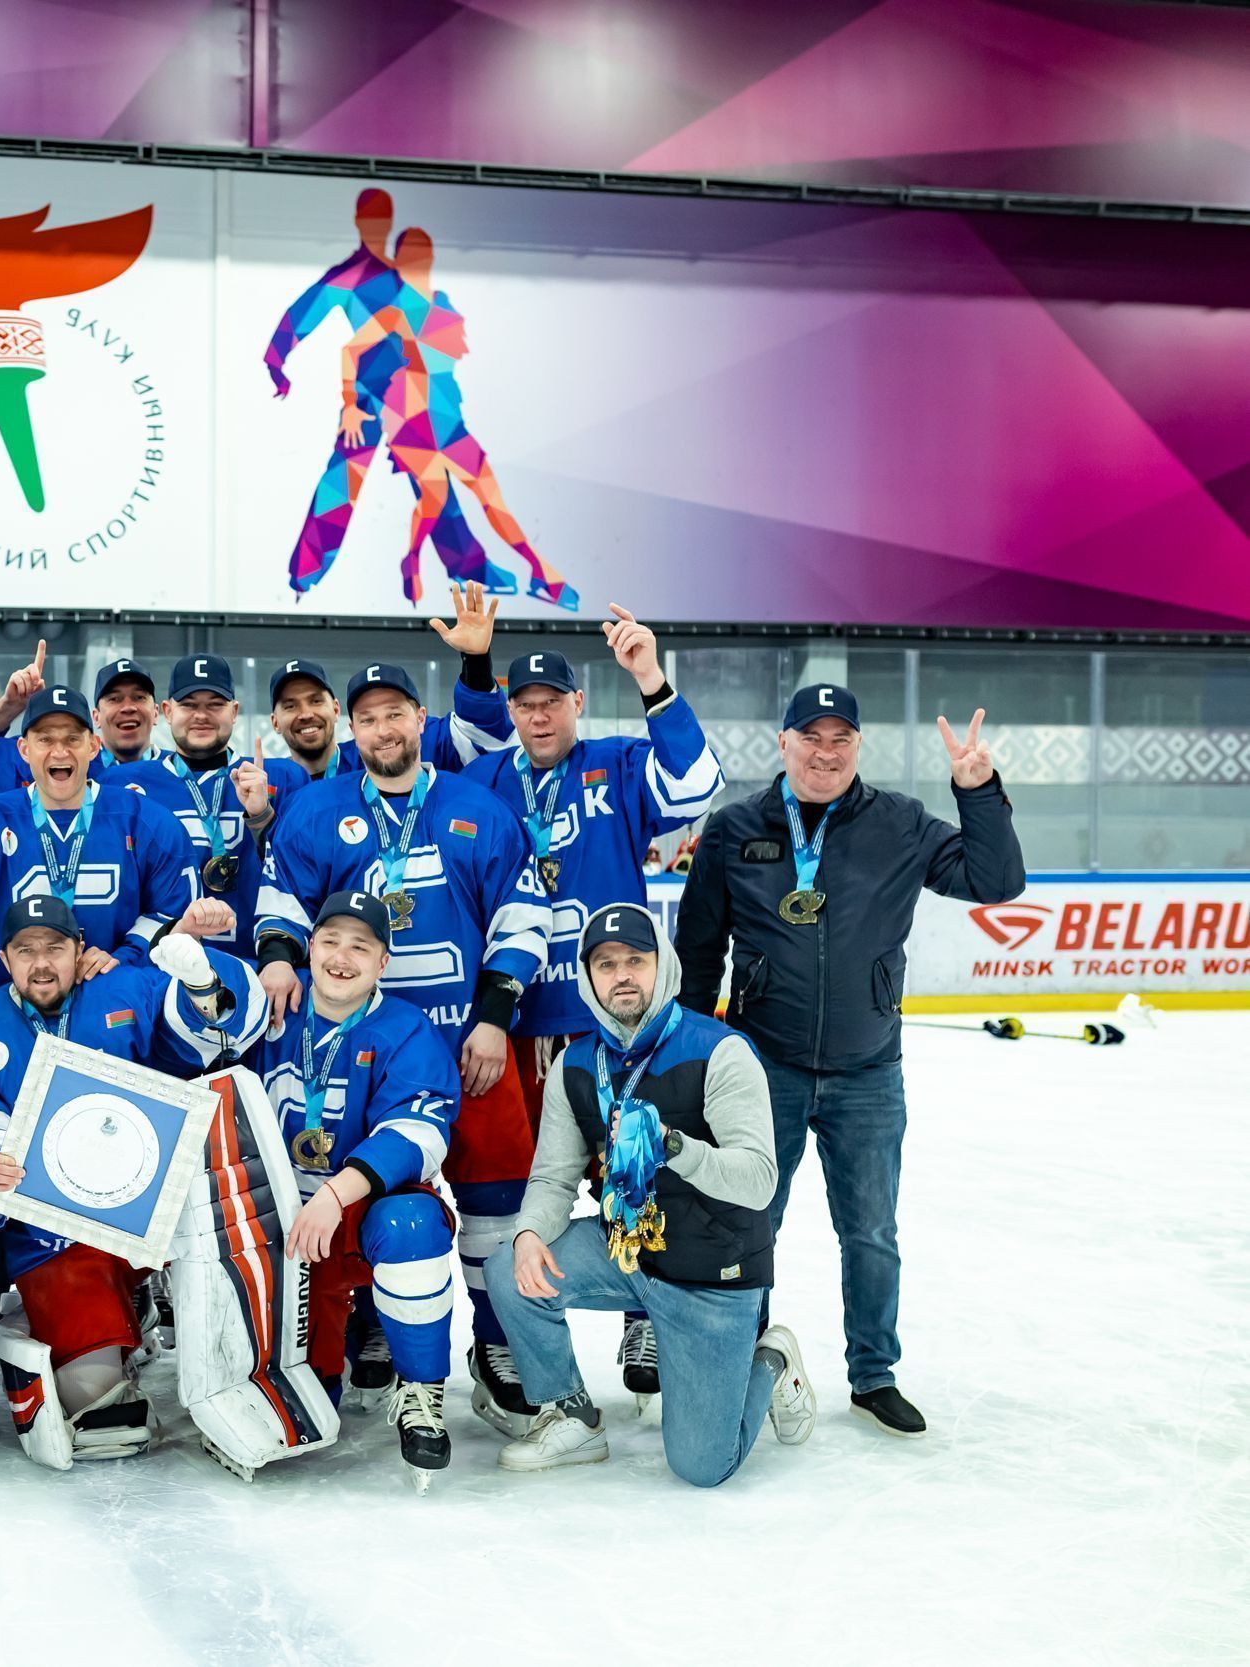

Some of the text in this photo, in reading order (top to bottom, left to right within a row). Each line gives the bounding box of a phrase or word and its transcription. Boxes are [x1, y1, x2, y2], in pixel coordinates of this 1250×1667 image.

[65, 307, 134, 364] КЛУБ
[67, 374, 165, 563] СПОРТИВНЫЙ
[972, 959, 1054, 977] MINSK
[1072, 958, 1186, 976] TRACTOR
